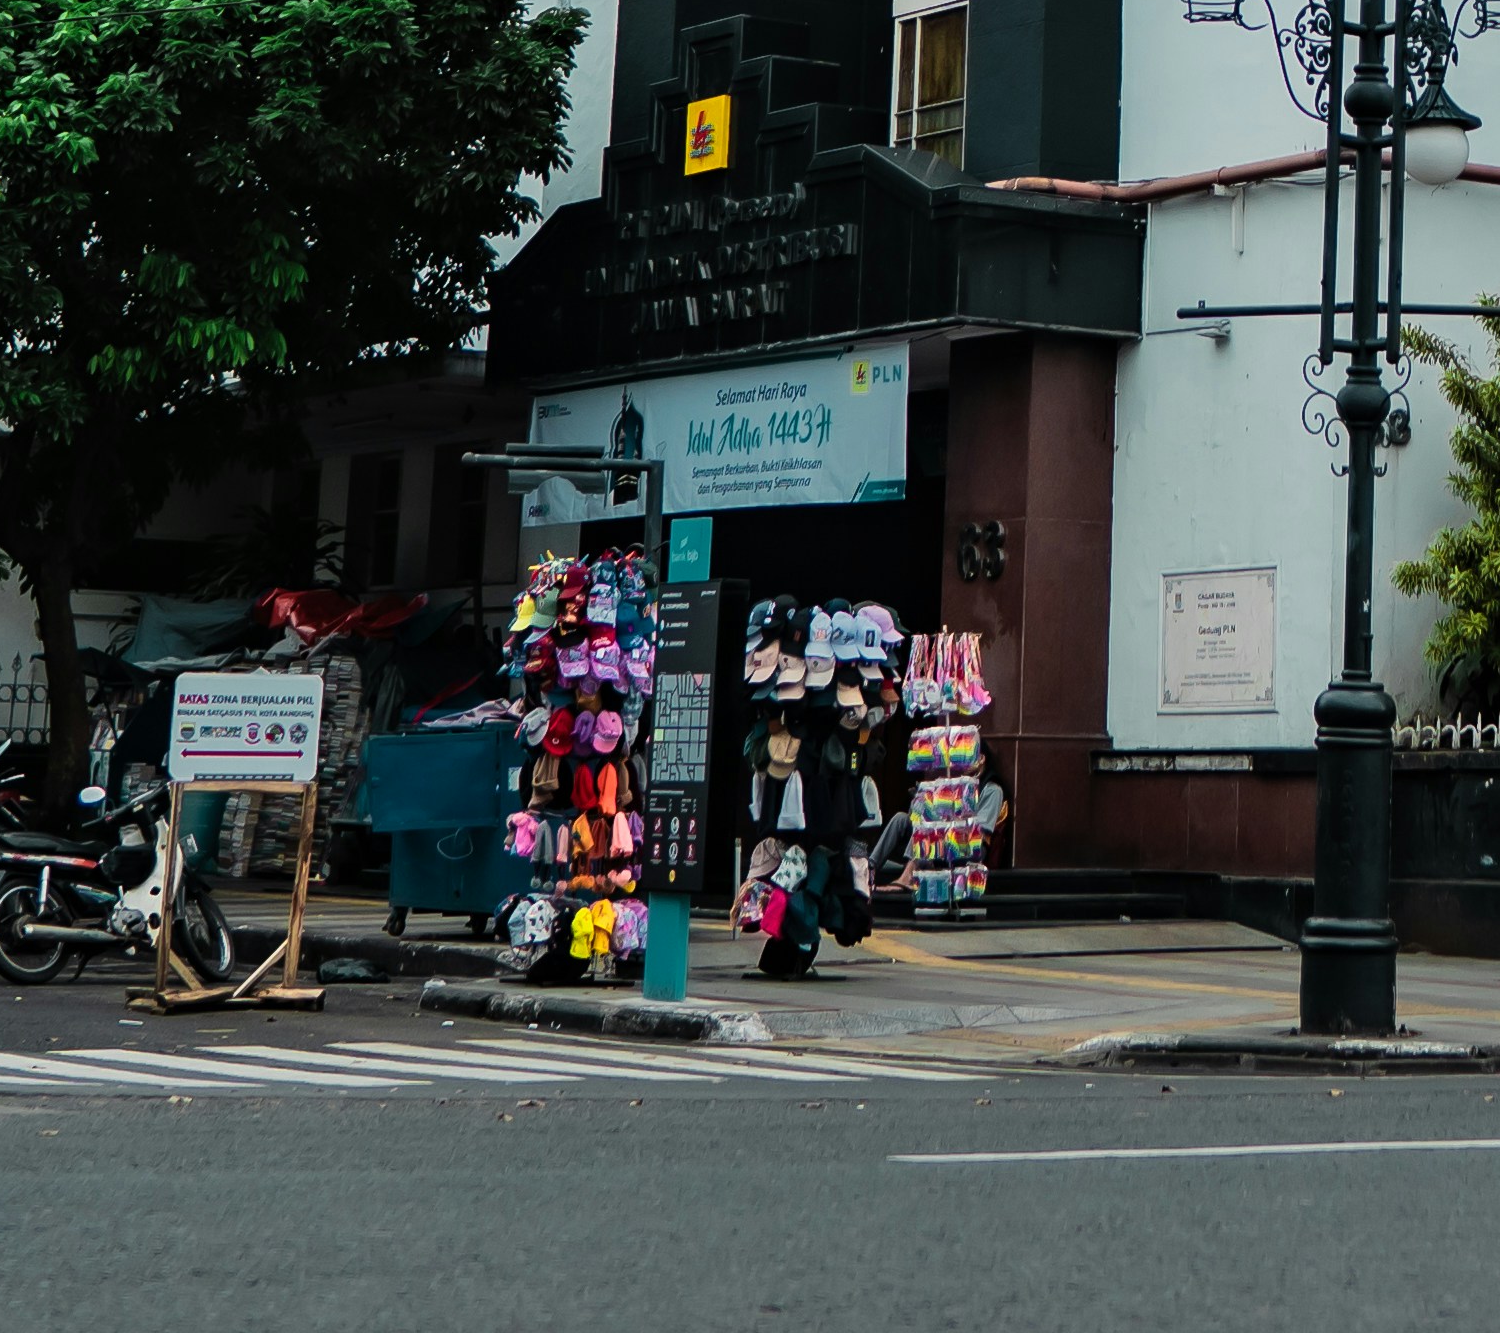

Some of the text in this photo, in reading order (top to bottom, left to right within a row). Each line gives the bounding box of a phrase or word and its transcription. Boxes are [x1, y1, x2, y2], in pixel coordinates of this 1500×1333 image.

[716, 223, 859, 274] DISTRIBUSI
[706, 282, 791, 327] BARAT
[872, 364, 902, 384] PLN
[715, 382, 808, 407] Selamat Hari Raya
[686, 418, 716, 457] Idul
[717, 412, 764, 456] Adha
[691, 466, 725, 481] Semangat
[760, 459, 781, 473] Bukti
[697, 482, 710, 495] dan
[754, 479, 774, 494] yang
[773, 476, 812, 492] Sempurna
[1198, 624, 1236, 636] Gedung PLN
[178, 694, 315, 707] BATAS ZONA BERJUALAN PKL
[243, 709, 258, 718] PKL
[259, 709, 278, 718] KOTA
